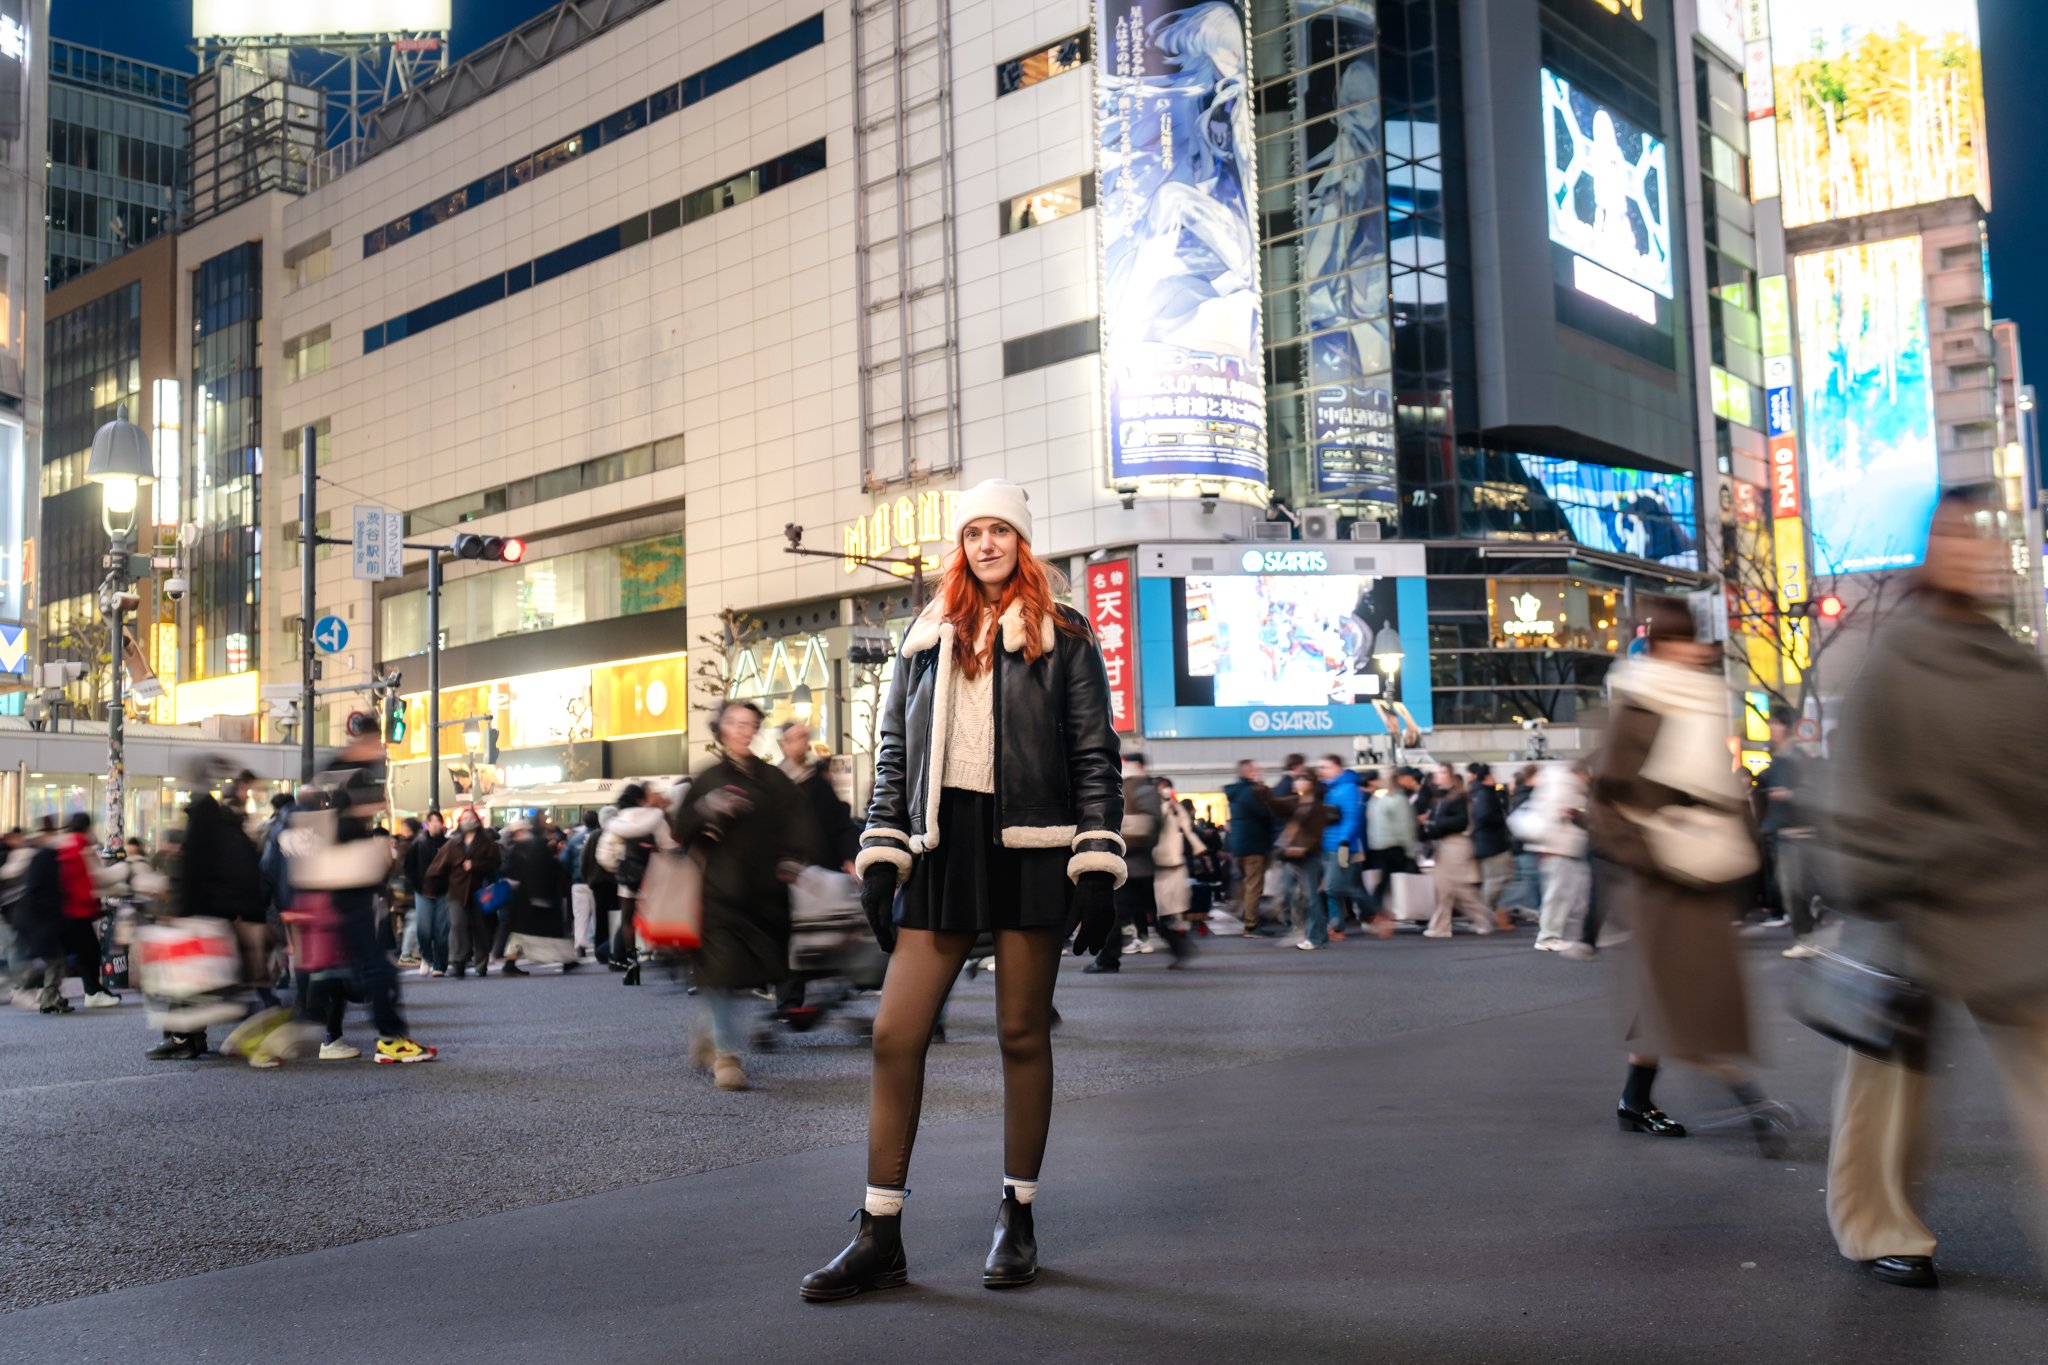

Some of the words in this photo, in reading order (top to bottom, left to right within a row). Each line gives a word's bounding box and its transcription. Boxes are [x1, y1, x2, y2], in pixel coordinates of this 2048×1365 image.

[366, 511, 380, 575] 渋谷駅前
[1264, 551, 1328, 572] STARTS
[1093, 570, 1124, 589] 名物
[1503, 620, 1555, 635] COFFEE
[1270, 710, 1334, 731] STARTS
